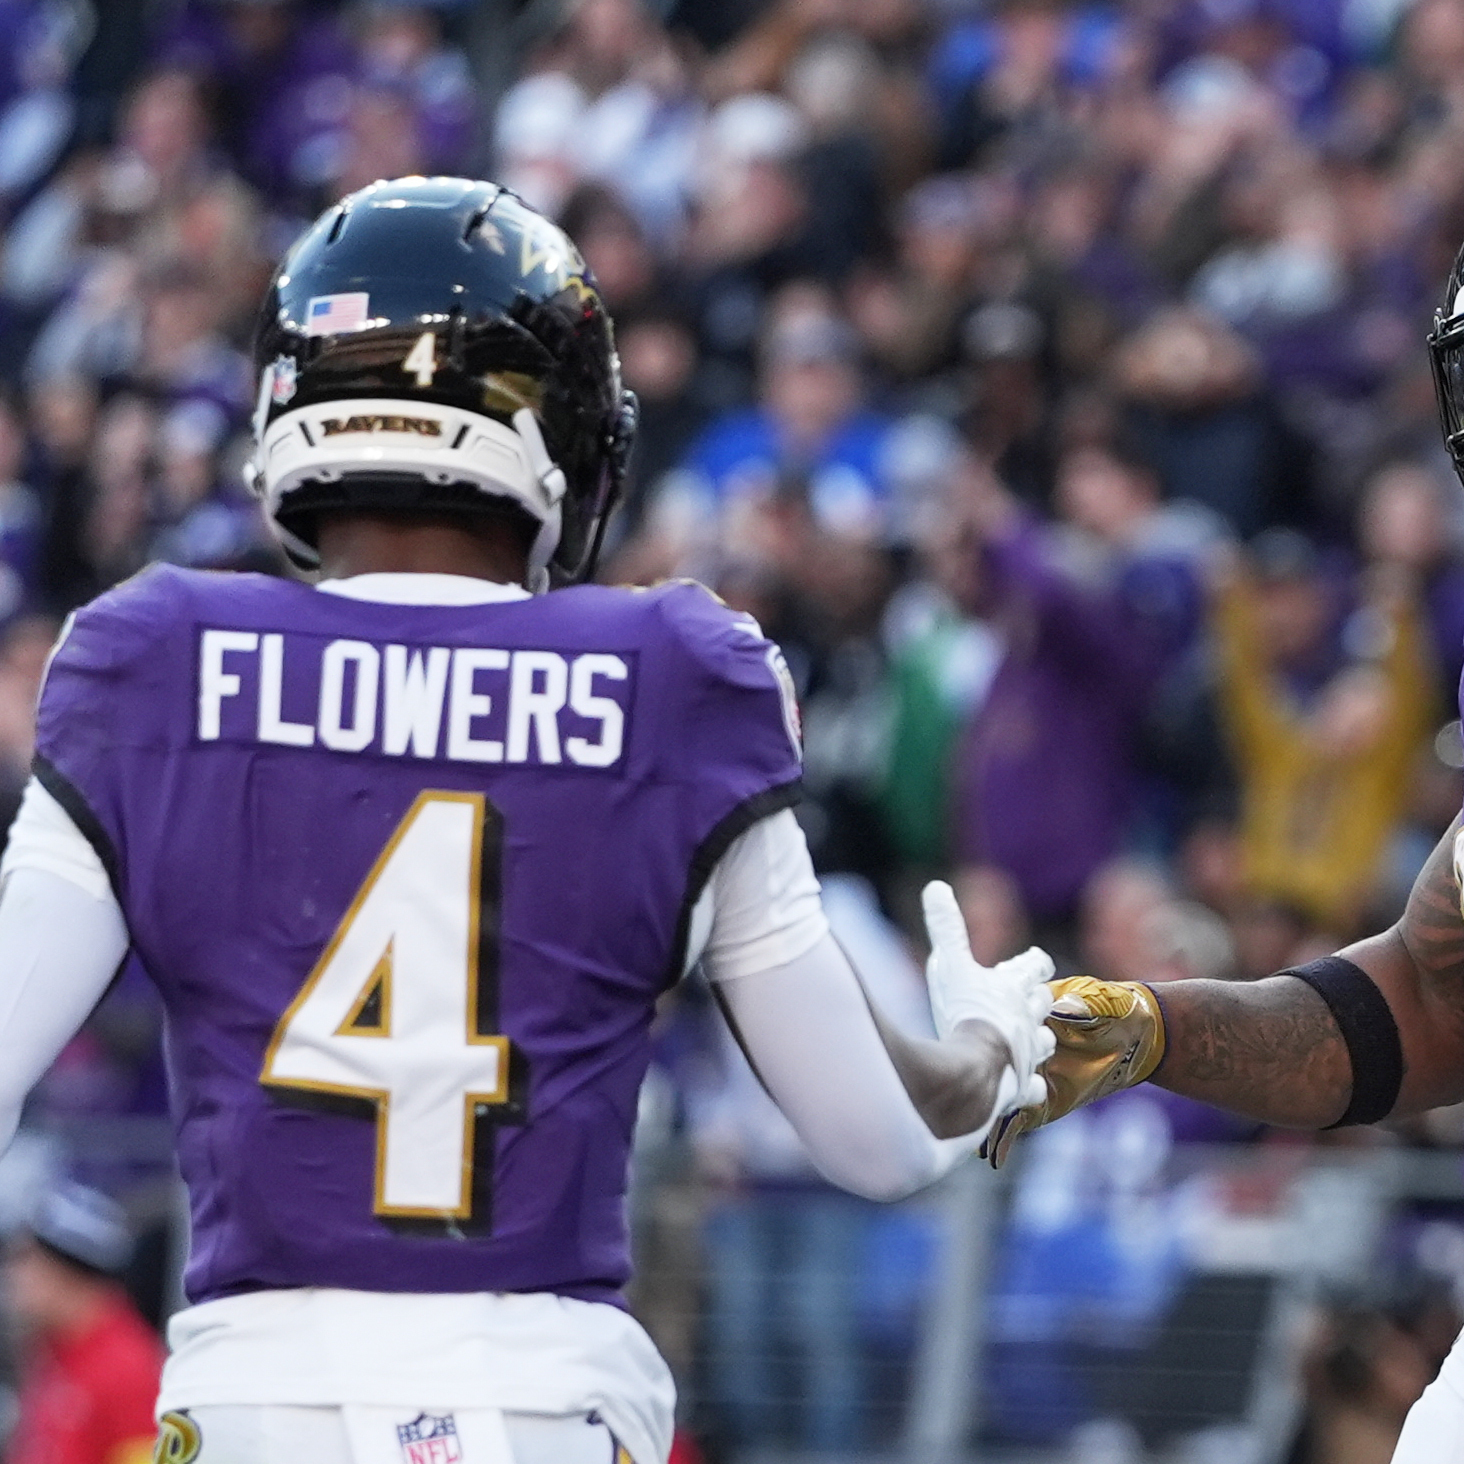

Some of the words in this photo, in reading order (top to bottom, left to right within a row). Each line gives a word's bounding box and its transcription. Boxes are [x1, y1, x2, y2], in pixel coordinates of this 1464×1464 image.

[402, 332, 438, 387] 4
[320, 415, 443, 438] RAVENS
[197, 629, 628, 768] FLOWERS
[260, 789, 522, 1228] 4
